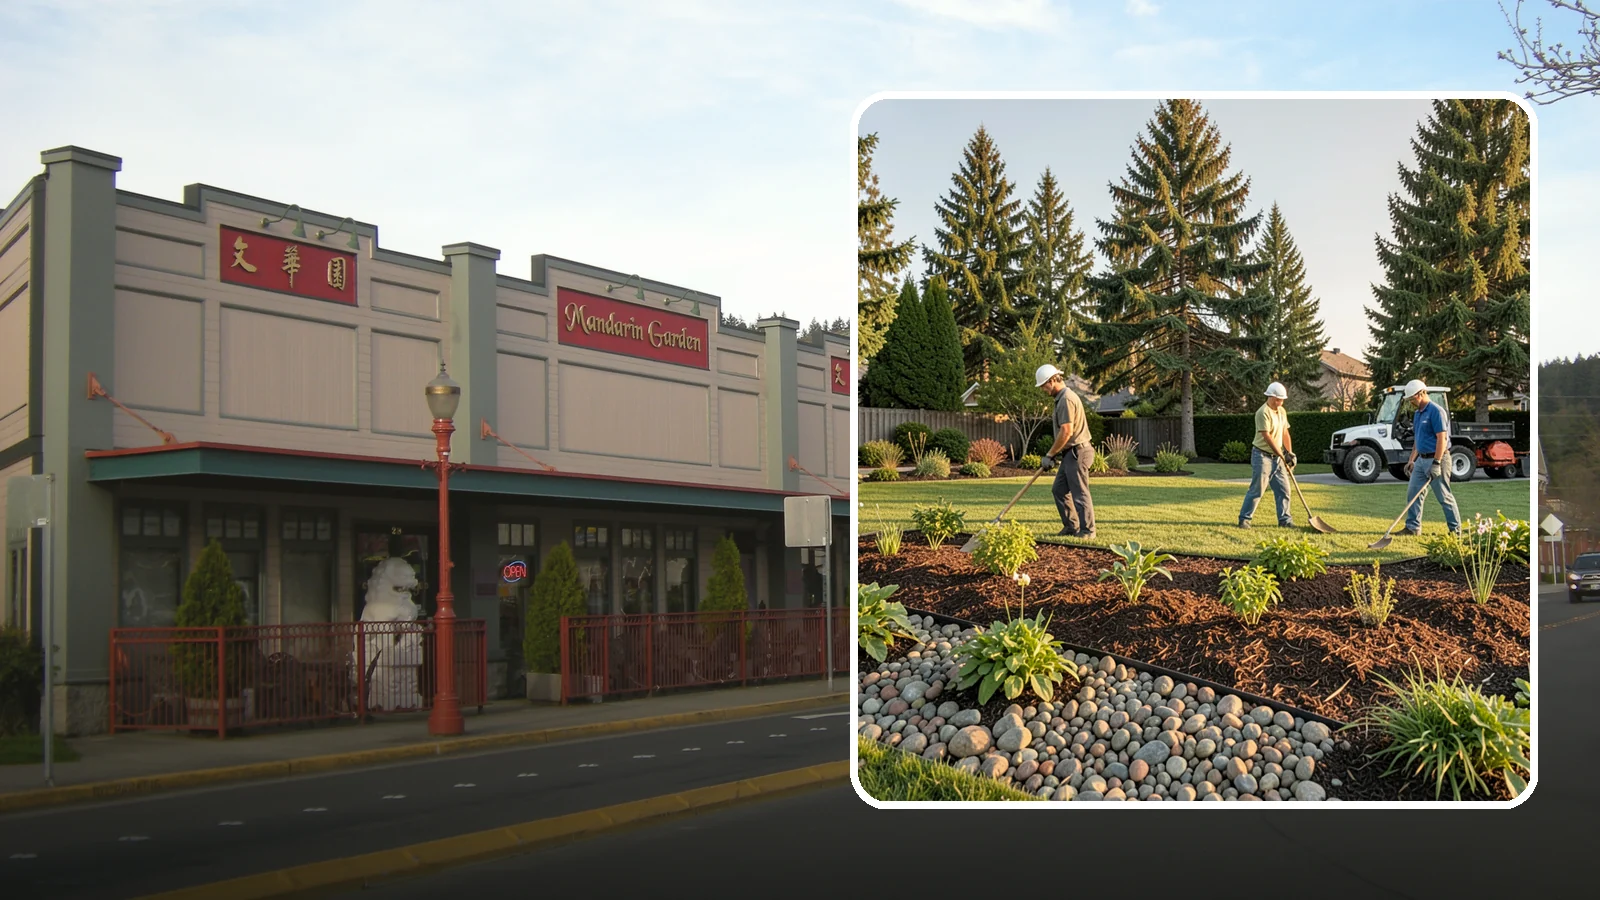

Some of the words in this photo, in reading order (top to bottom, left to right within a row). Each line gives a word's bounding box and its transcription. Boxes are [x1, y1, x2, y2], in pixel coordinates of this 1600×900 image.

[230, 235, 347, 291] 文華園
[564, 302, 644, 341] Mandarin
[648, 320, 702, 352] Garden
[503, 565, 527, 578] OPEN
